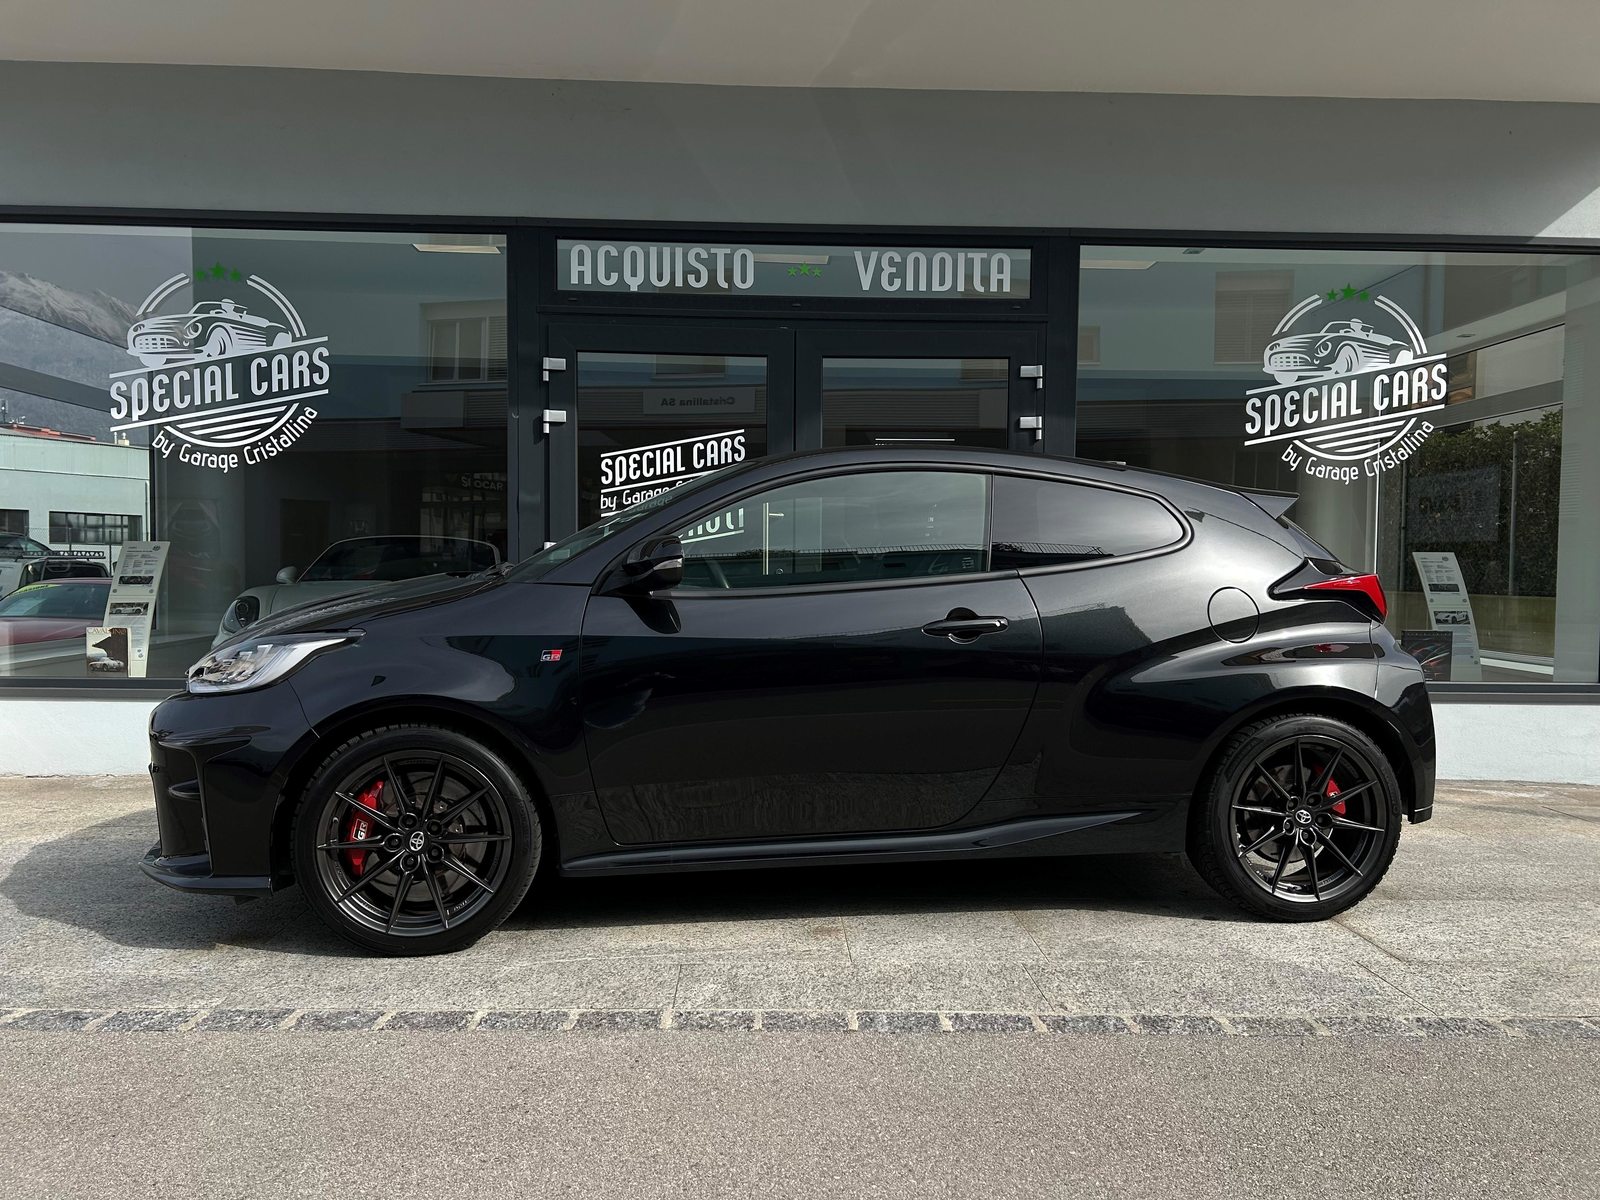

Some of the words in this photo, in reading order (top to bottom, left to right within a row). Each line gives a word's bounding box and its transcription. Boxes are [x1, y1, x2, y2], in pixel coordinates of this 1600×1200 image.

[570, 244, 755, 292] ACQUISTO
[853, 250, 1011, 293] VENDITA
[109, 362, 239, 422] SPECIAL
[250, 346, 330, 396] CARS
[1245, 379, 1362, 436] SPECIAL
[1373, 363, 1447, 411] CARS
[151, 430, 175, 459] by
[178, 443, 239, 474] Garage
[244, 405, 318, 465] Cristallina
[600, 446, 686, 486] SPECIAL
[692, 435, 746, 469] CARS
[1281, 444, 1303, 471] by
[1305, 457, 1359, 485] Garage
[1363, 420, 1435, 477] Cristallina
[600, 494, 617, 511] by
[356, 820, 368, 840] GR
